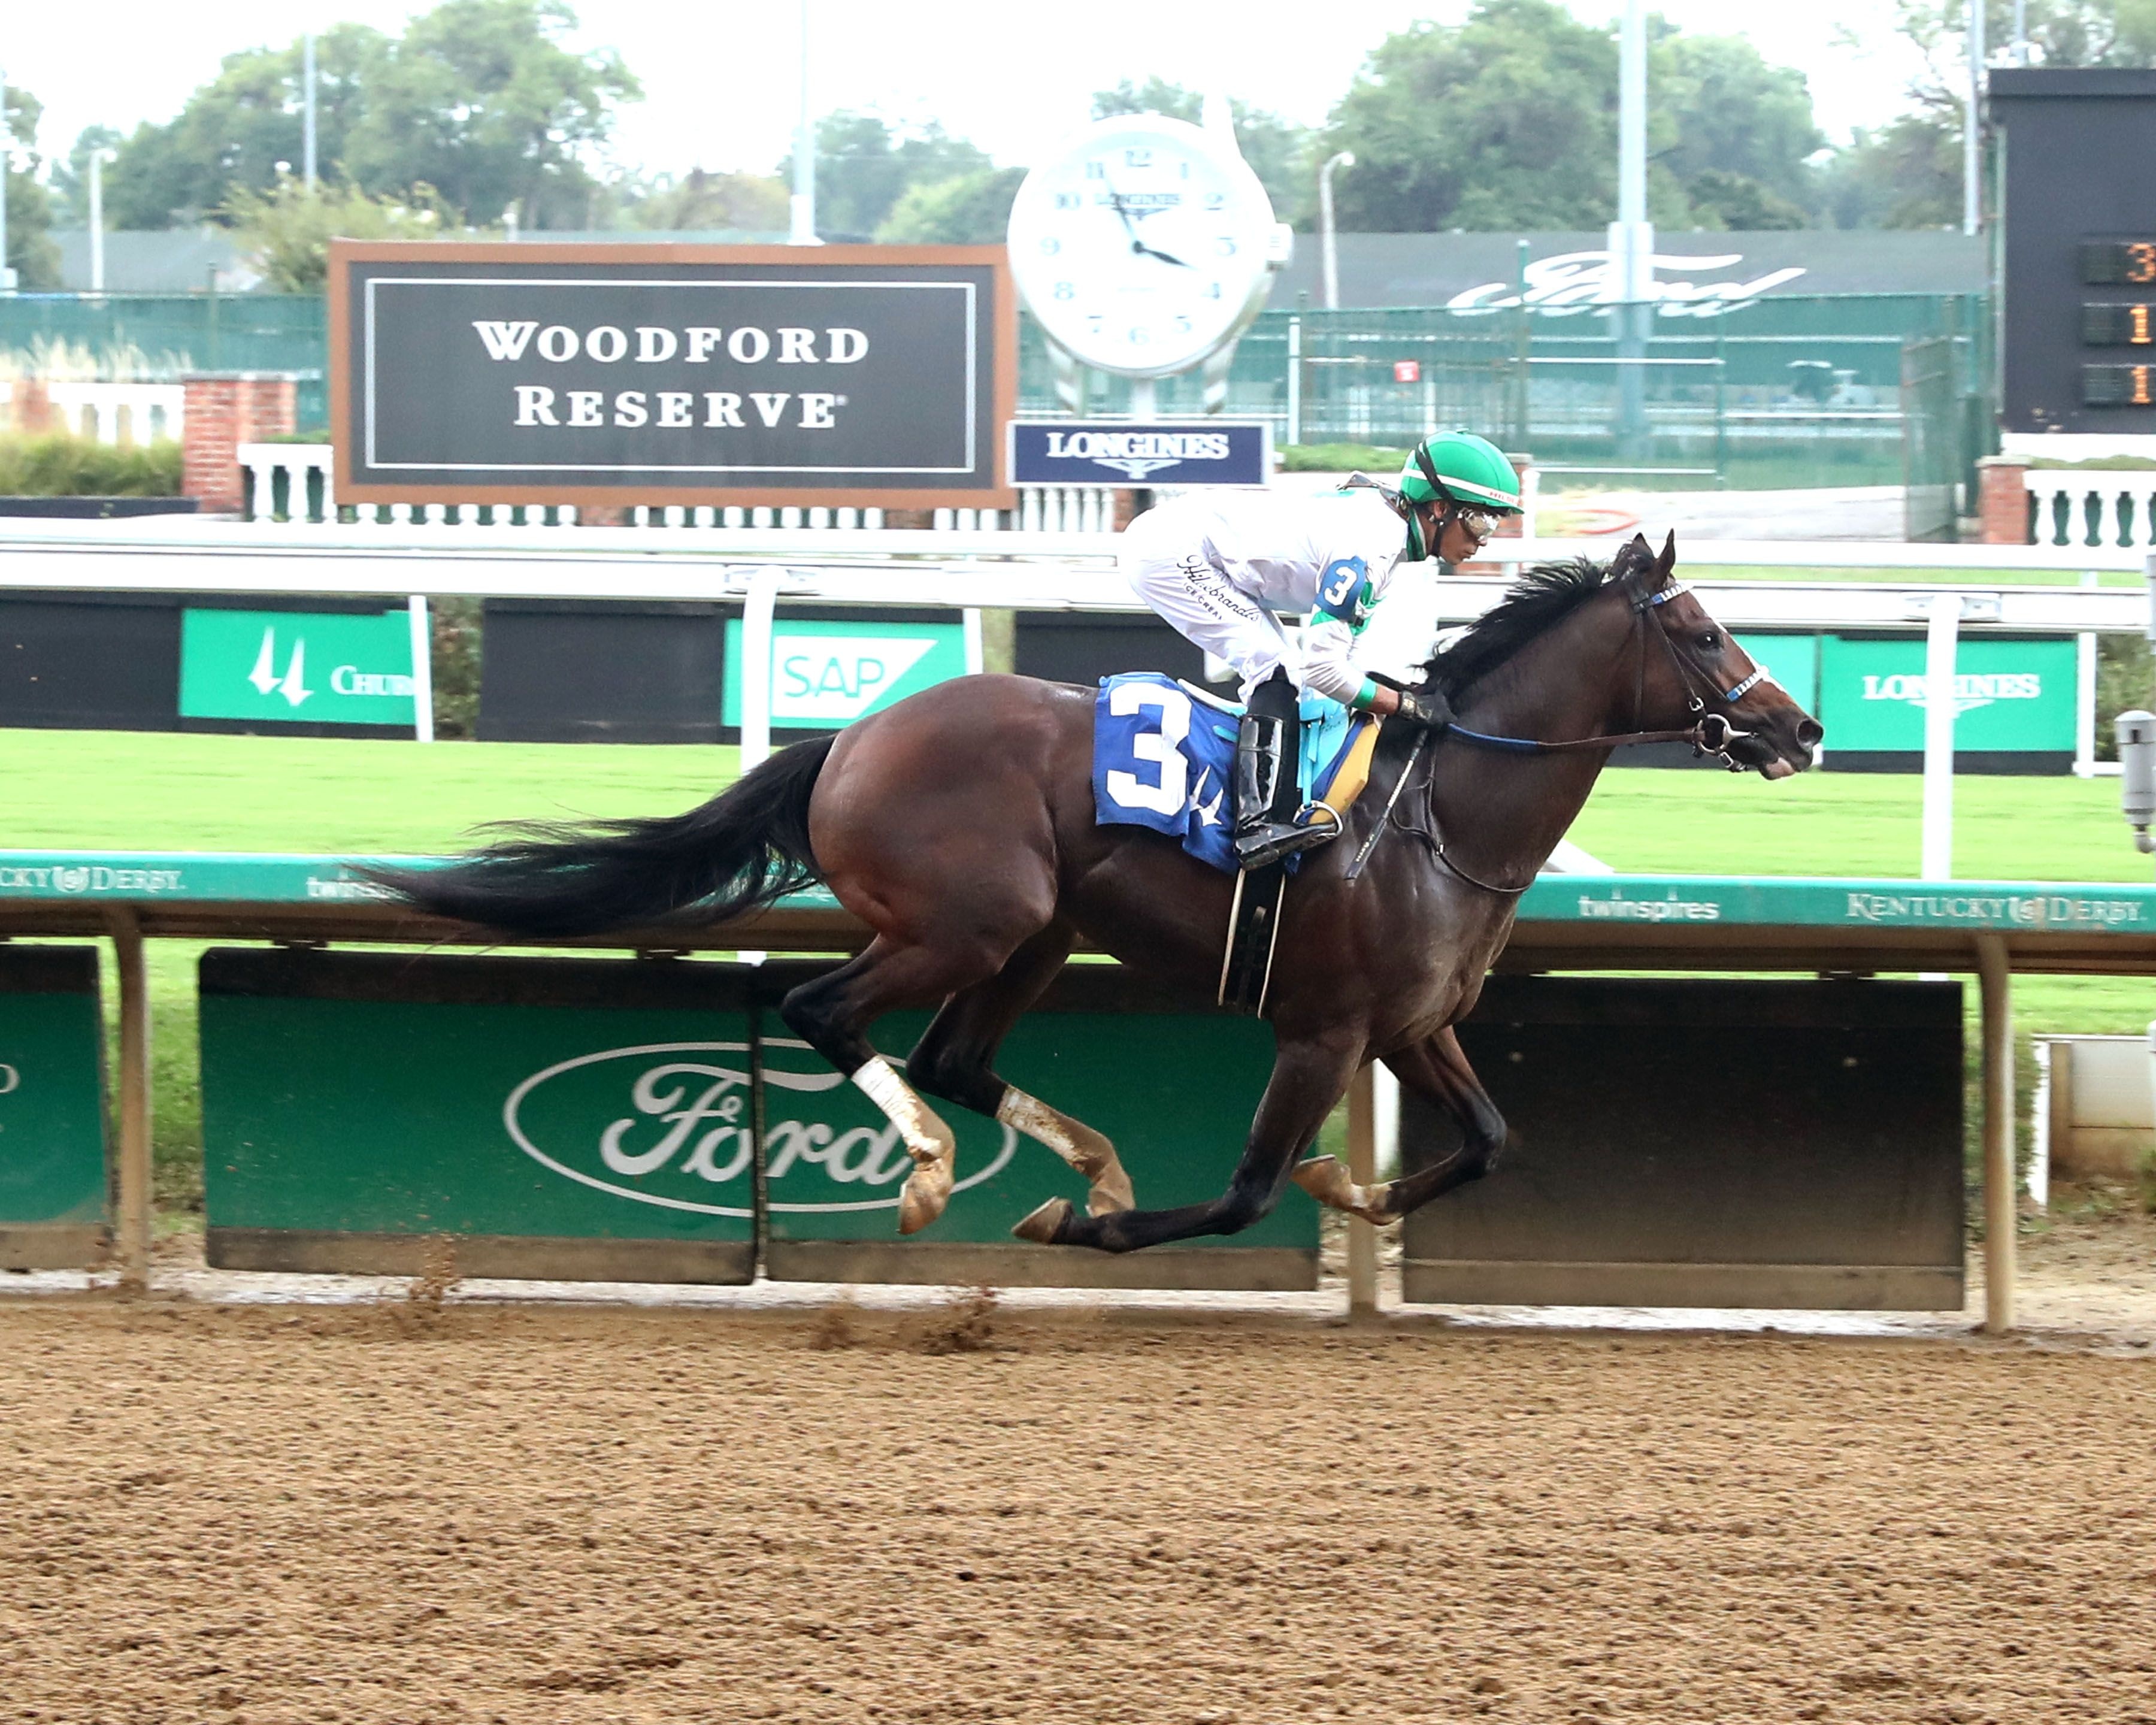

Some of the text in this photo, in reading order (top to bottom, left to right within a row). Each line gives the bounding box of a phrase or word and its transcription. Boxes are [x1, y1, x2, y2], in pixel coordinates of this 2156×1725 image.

[1086, 162, 1105, 179] 11
[1125, 150, 1152, 167] 12
[1180, 162, 1189, 179] 1
[1055, 192, 1082, 210] 10
[1204, 192, 1224, 211] 2
[1039, 237, 1061, 256] 9
[1215, 237, 1237, 256] 3
[2127, 243, 2156, 282] 3
[1052, 281, 1076, 299] 8
[1200, 282, 1221, 299] 4
[1086, 314, 1105, 334] 7
[1127, 326, 1150, 345] 6
[1173, 314, 1193, 334] 5
[2130, 304, 2152, 343] 1
[472, 321, 869, 363] WOODFORD
[2130, 365, 2152, 404] 1
[513, 385, 836, 428] RESERVE
[1046, 431, 1230, 460] LONGINES
[1324, 566, 1358, 606] 3
[784, 655, 885, 698] SAP
[1107, 682, 1192, 816] 3
[91, 867, 182, 894] DERBY
[1577, 888, 1720, 923] twinspires
[1845, 893, 2144, 924] KENTUCKY DERBY
[601, 1063, 912, 1185] Ford
